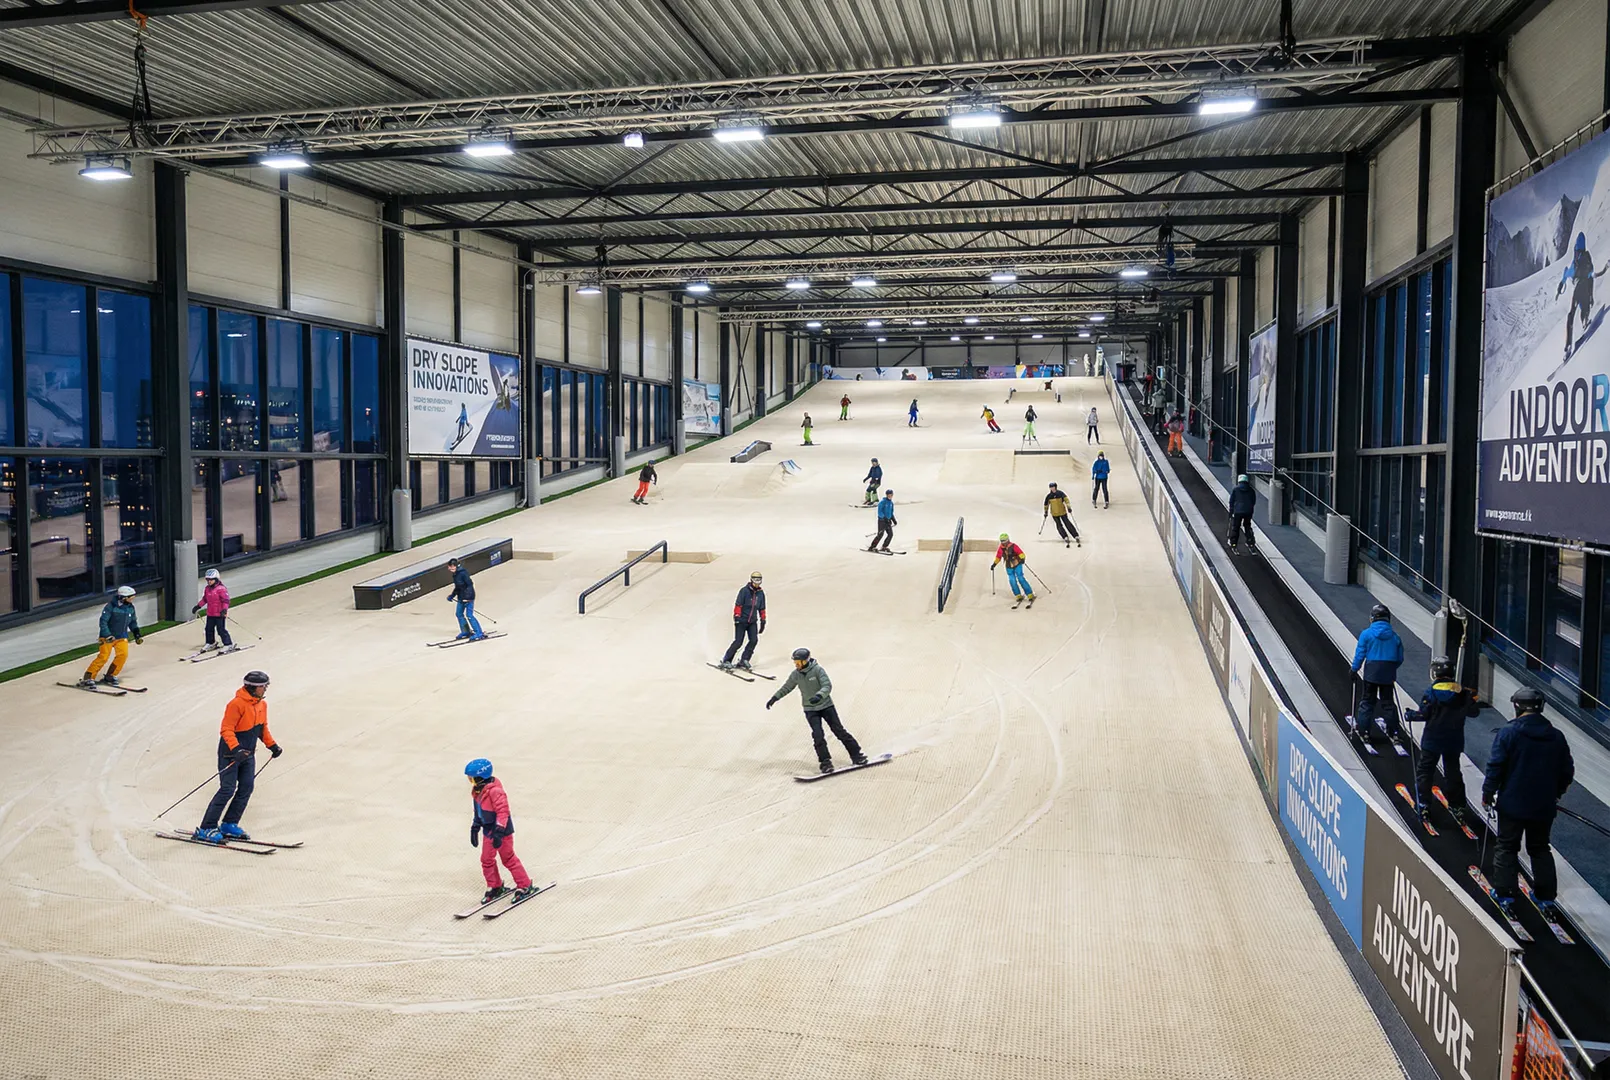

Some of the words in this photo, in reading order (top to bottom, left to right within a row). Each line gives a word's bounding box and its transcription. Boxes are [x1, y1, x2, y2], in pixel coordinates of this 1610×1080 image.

[413, 348, 438, 369] DRY
[441, 352, 478, 375] SLOPE
[413, 370, 488, 396] INNOVATIONS
[1510, 374, 1610, 440] INDOOR
[1499, 439, 1610, 484] ADVENTUR
[1289, 743, 1308, 788] DRY
[1308, 764, 1342, 838] SLOPE
[1286, 779, 1349, 901] INNOVATIONS
[1392, 865, 1460, 993] INDOOR
[1373, 903, 1474, 1080] ADVENTURE
